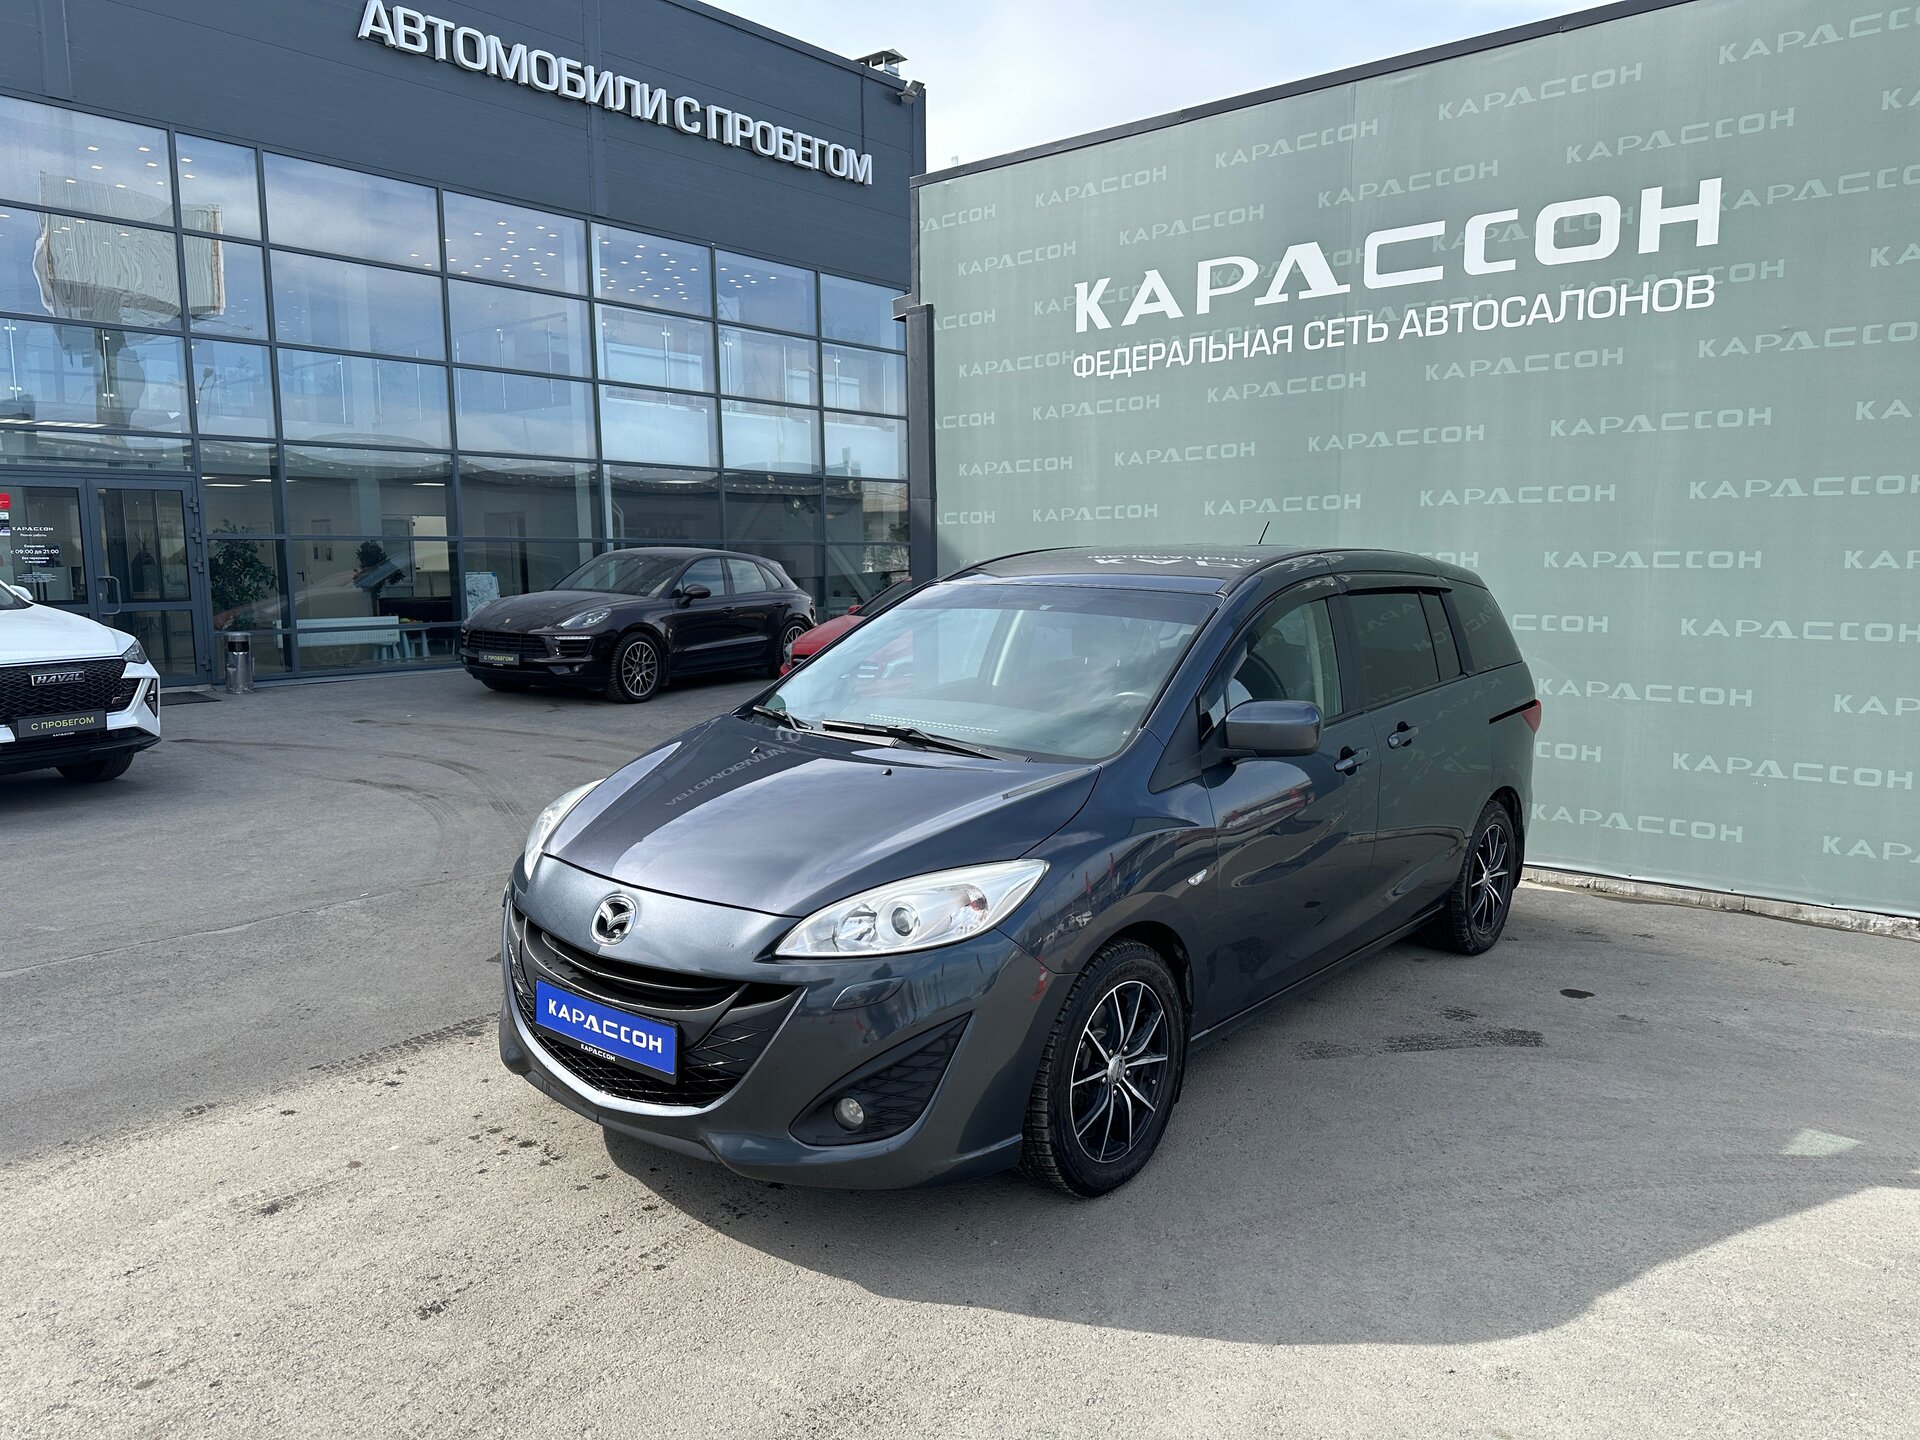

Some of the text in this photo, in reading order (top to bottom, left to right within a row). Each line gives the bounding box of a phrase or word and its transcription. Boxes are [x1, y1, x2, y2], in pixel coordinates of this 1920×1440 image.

[1718, 5, 1920, 65] КАРАСС
[357, 0, 873, 186] АВТОМОБИЛИ С ПРОБЕГОМ
[1074, 177, 1723, 334] КАРАССОН
[1073, 274, 1716, 379] ФЕДЕРАЛЬНАЯ СЕТЬ АВТОСАЛОНОВ
[36, 673, 83, 684] HAVAL
[31, 716, 95, 731] С ПРОБЕГОМ
